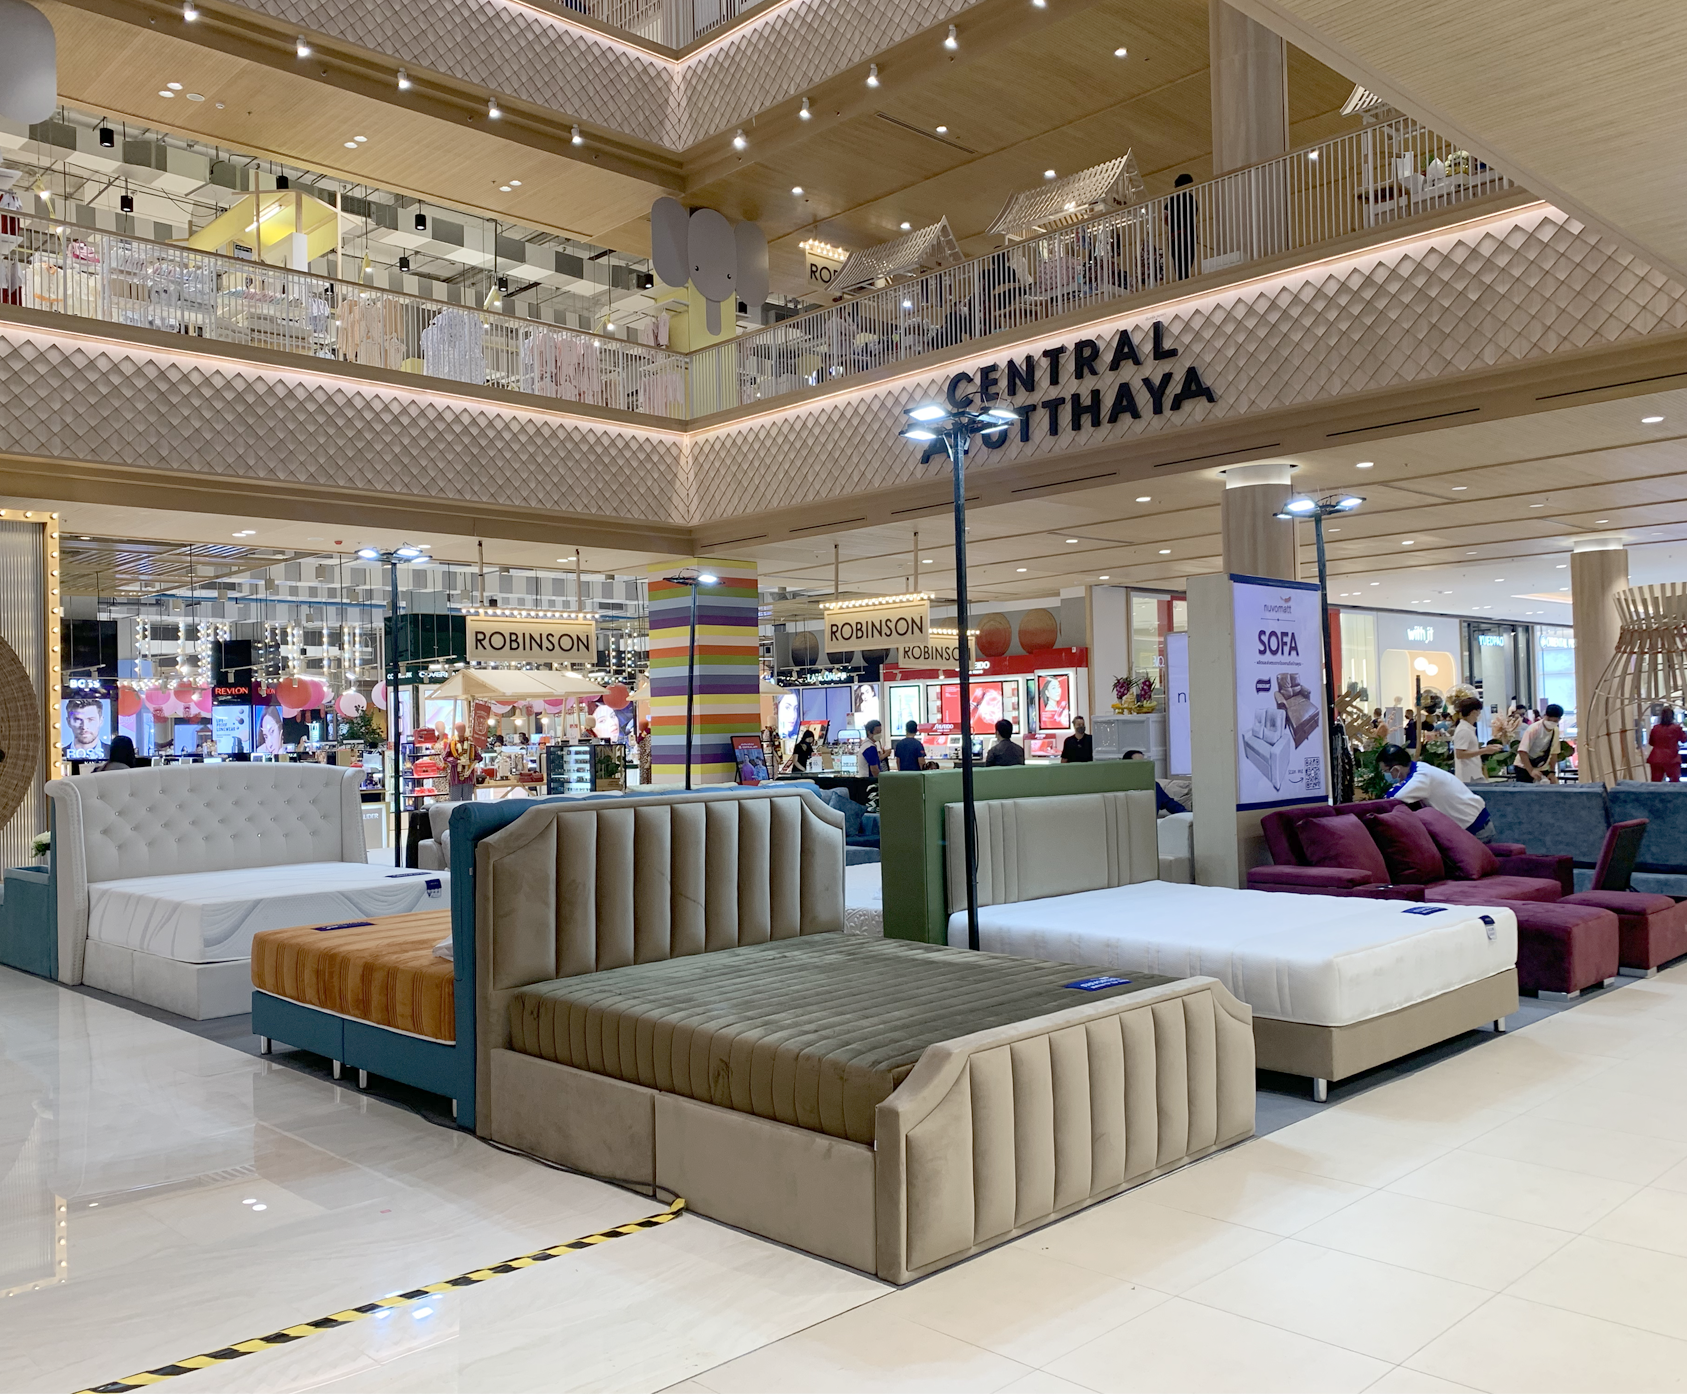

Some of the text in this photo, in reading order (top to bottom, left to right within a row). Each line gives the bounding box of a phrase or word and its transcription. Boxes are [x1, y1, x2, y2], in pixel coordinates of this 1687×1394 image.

[947, 321, 1178, 409] CENTRAL
[920, 366, 1217, 464] AUTTHAYA
[1264, 604, 1292, 614] nuvomatt
[830, 616, 923, 641] ROBINSON
[475, 631, 590, 652] ROBINSON
[1258, 629, 1299, 657] SOFA
[70, 680, 100, 688] BOSS
[215, 687, 248, 695] REVLON
[67, 749, 104, 758] BOSS
